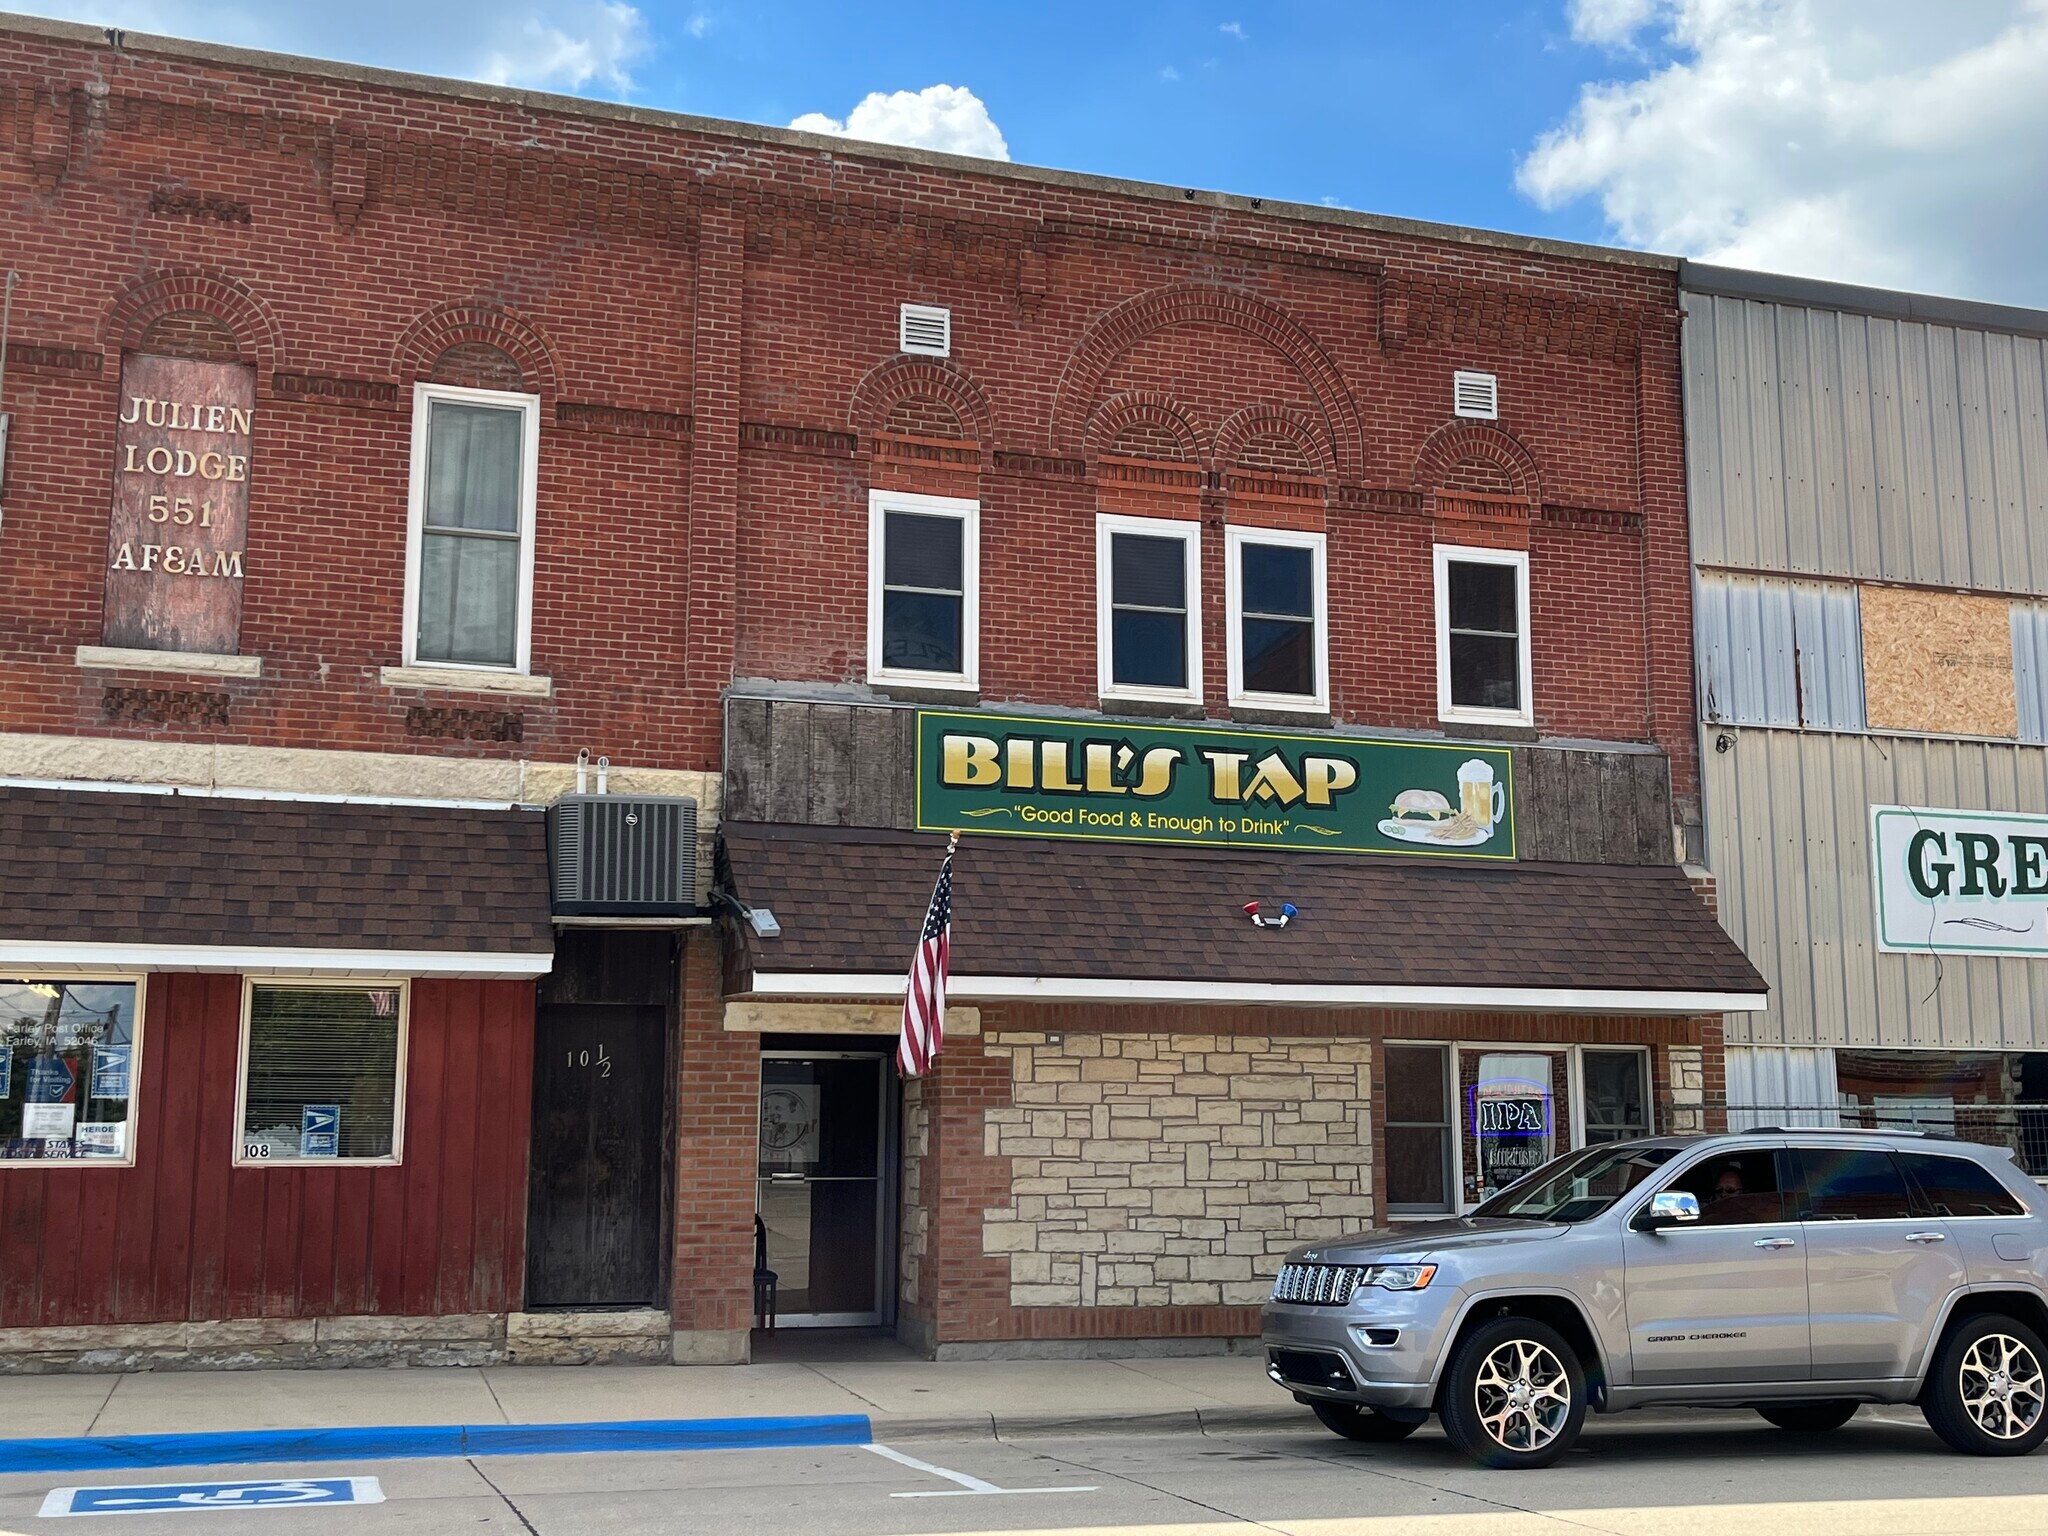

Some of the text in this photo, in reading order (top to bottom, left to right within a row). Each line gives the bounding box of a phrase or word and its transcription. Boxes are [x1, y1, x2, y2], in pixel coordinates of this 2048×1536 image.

[119, 397, 254, 436] JULIEN
[123, 444, 247, 482] LODGE
[148, 495, 211, 528] 551
[111, 542, 244, 578] AF&AM
[941, 733, 1357, 805] BILL'S TAP
[1014, 805, 1290, 836] "Good Food & Enough to Drink"
[1908, 828, 2048, 898] GRE
[7, 1022, 104, 1035] Farley Post Office
[46, 1036, 57, 1046] IA
[64, 1036, 98, 1046] 52046
[29, 1076, 41, 1084] for
[1481, 1103, 1541, 1130] IPA
[43, 1150, 87, 1158] SERVCE
[243, 1144, 270, 1158] 108
[1647, 1331, 1747, 1342] GRAND CHEROKEE
